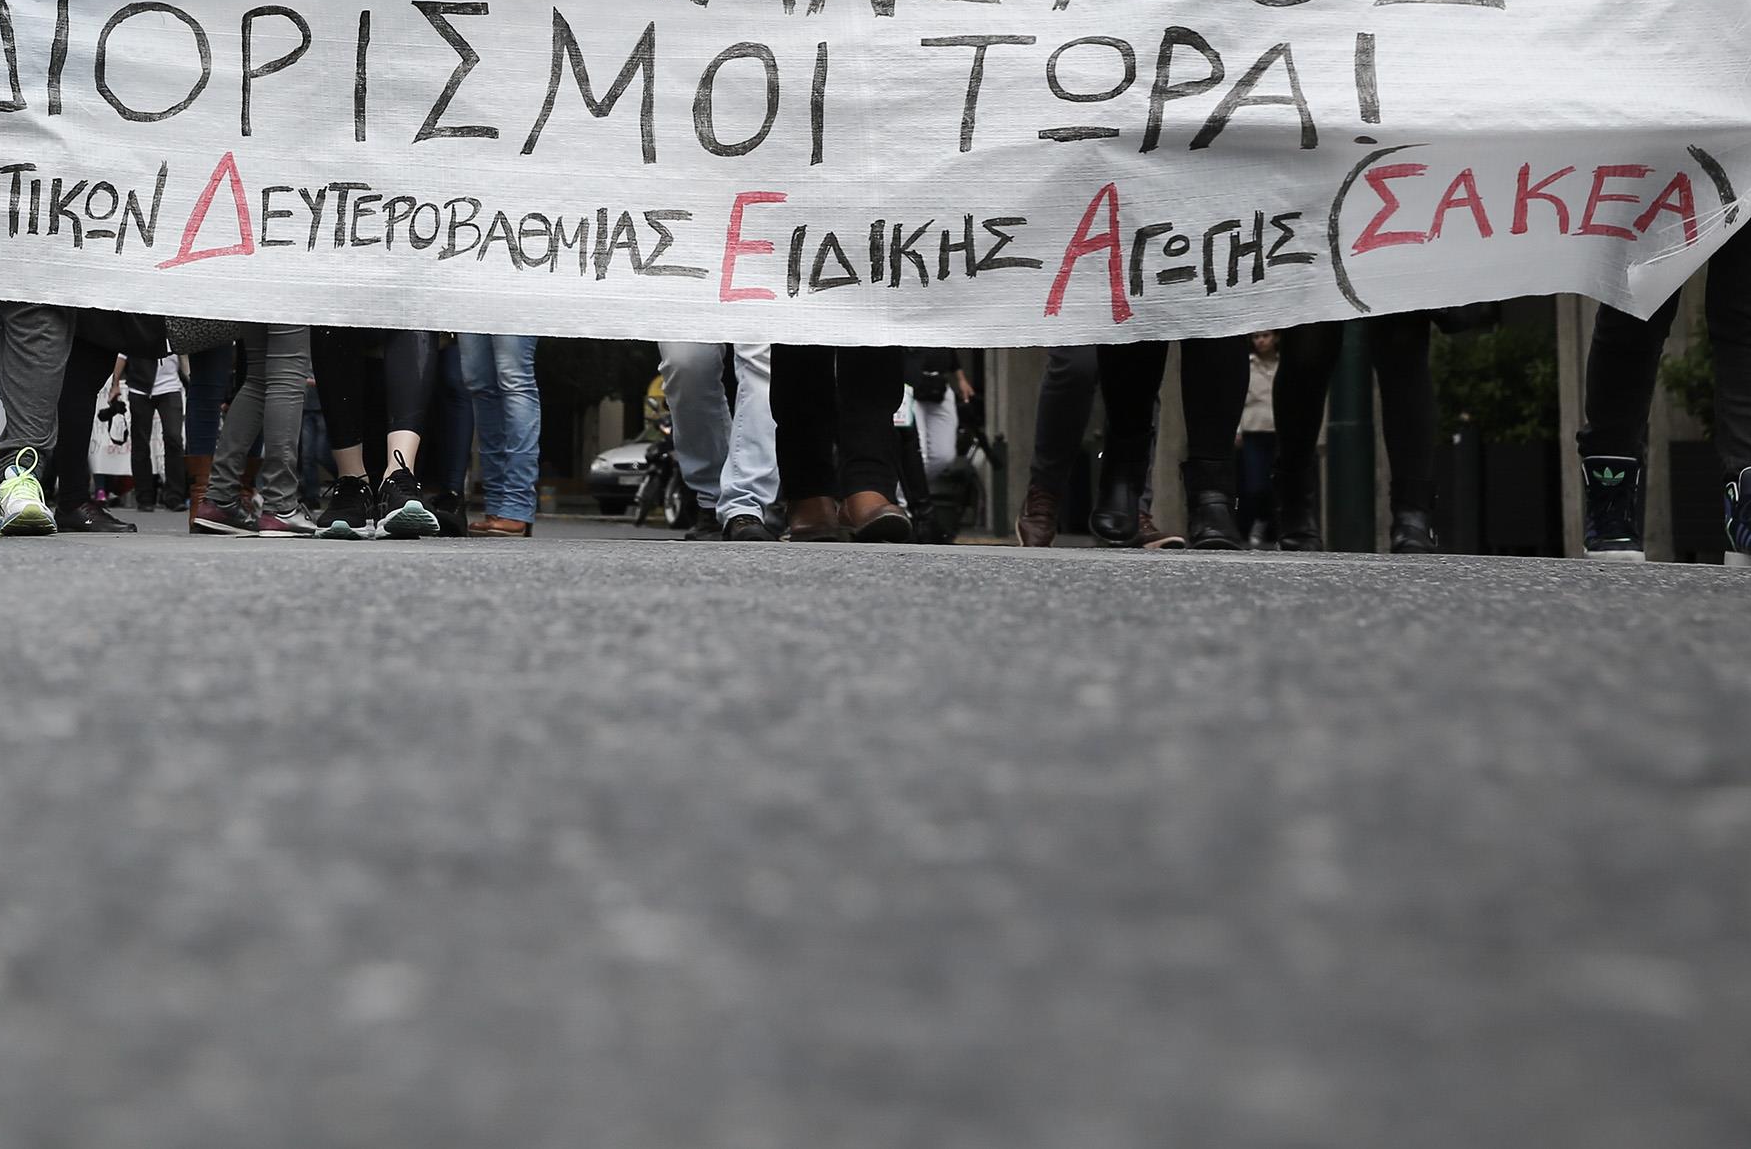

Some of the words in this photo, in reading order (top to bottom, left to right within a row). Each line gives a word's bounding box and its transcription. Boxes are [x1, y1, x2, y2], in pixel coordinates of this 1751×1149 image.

[920, 25, 1381, 153] ΤΩΡΑ!
[155, 151, 709, 281] ΔΕΥΤΕΡΟΒΑΘΜΙΑΣ
[719, 191, 1044, 303] ΕΙΔΙΚΗΣ
[1044, 181, 1318, 324] ΑΓΩΓΗΣ
[1328, 142, 1740, 313] (ΣΑΚΕΑ)
